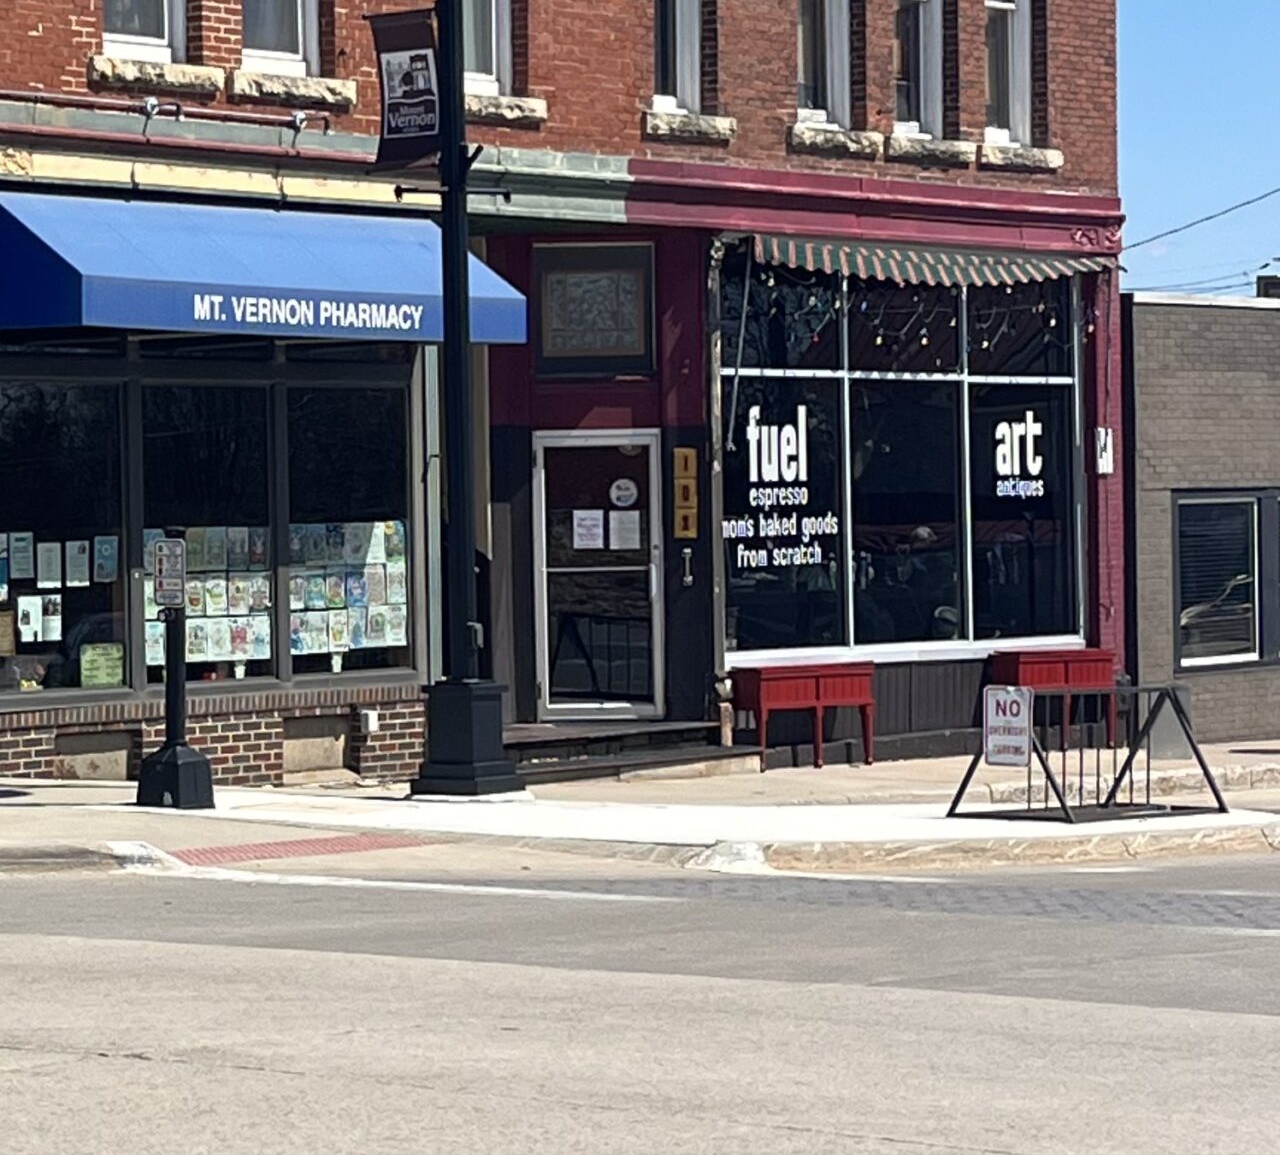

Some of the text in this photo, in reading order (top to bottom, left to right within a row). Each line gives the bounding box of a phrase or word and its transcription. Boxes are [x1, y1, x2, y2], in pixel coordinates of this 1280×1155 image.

[388, 112, 436, 128] Vernon
[194, 294, 423, 330] MT. VERNON PHARMACY
[746, 404, 808, 482] fuel
[995, 410, 1043, 476] art
[749, 486, 808, 511] espresso
[996, 477, 1045, 500] antiques
[759, 512, 797, 537] baked
[801, 511, 838, 543] goods
[737, 540, 822, 568] from scratch
[995, 699, 1021, 717] NO
